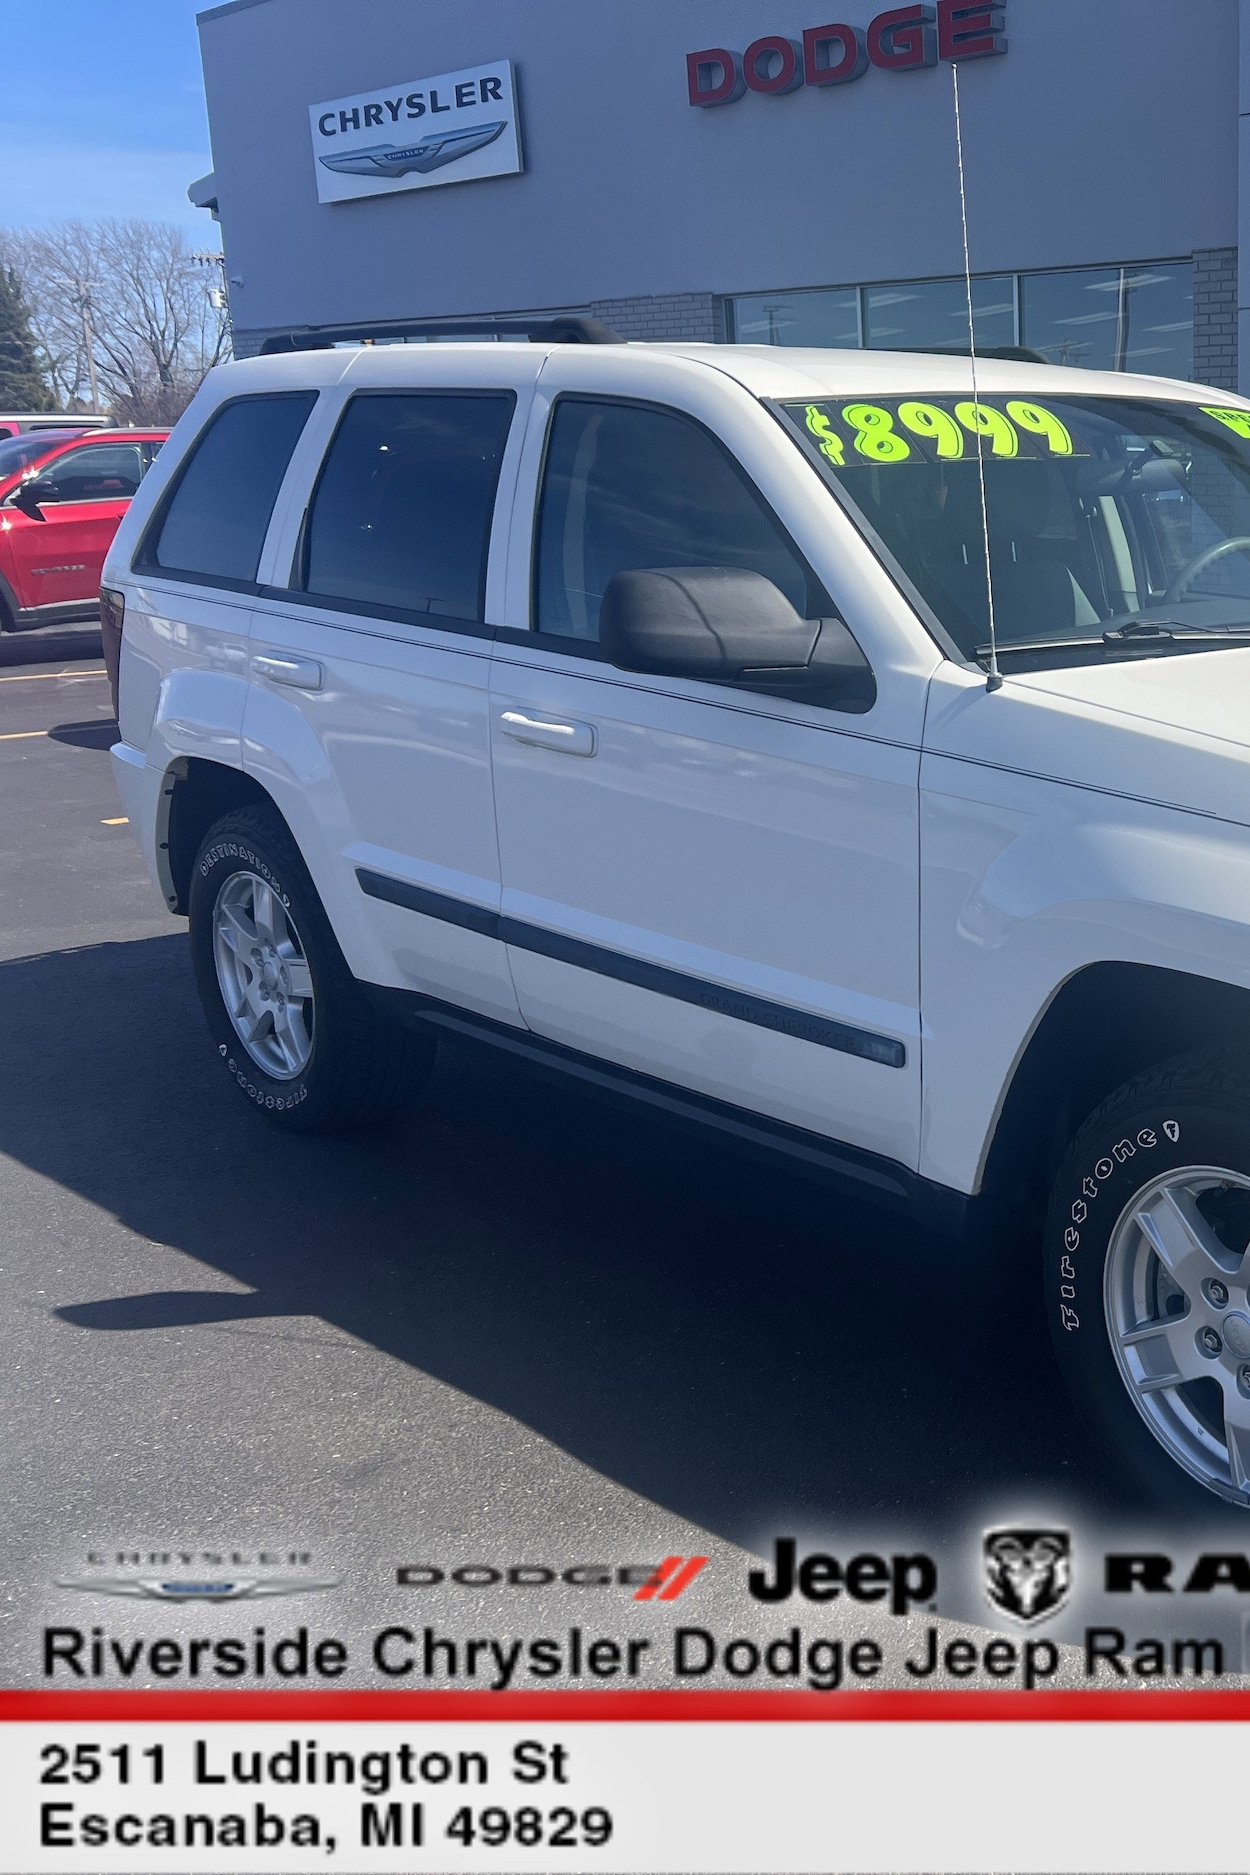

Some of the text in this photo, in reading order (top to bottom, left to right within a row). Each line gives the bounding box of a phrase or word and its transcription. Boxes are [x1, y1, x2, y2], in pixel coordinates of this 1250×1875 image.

[687, 0, 1006, 108] DODGE
[318, 76, 505, 138] CHRYSLER
[805, 400, 1073, 466] $8999
[200, 843, 281, 893] DESTINATION
[1060, 1128, 1157, 1332] Firestone
